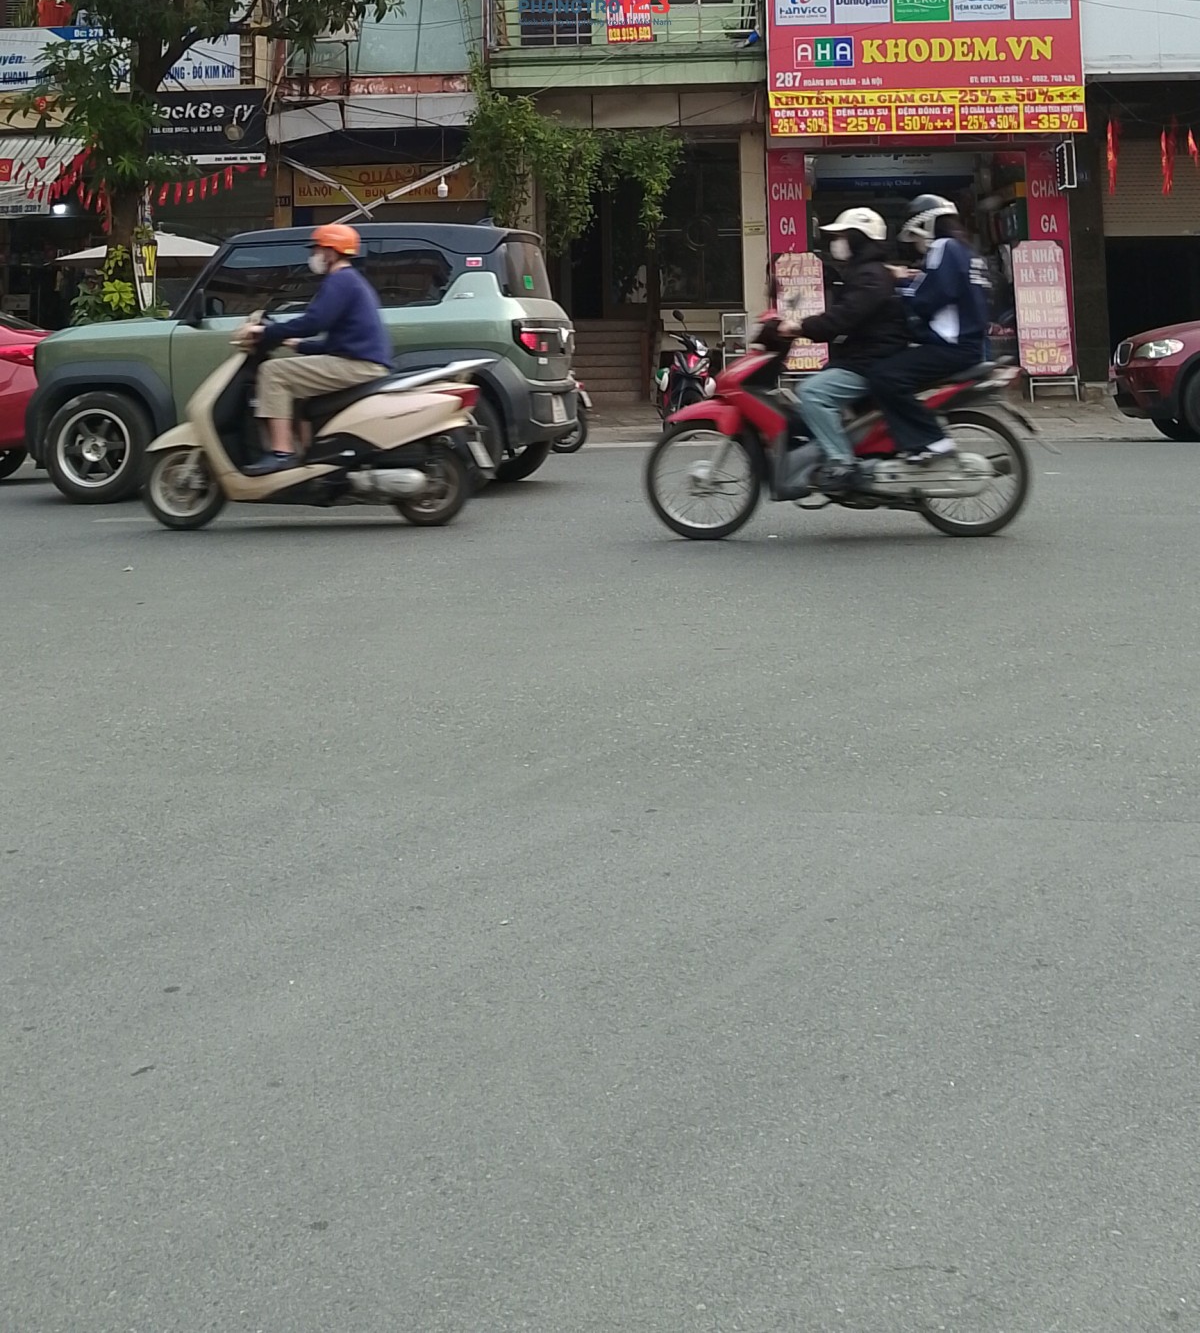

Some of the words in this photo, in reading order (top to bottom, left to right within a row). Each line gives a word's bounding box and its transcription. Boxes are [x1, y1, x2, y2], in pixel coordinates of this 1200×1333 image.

[797, 42, 851, 62] AHA
[861, 36, 1054, 64] KHODEM.VN
[204, 65, 220, 79] KIM
[776, 72, 802, 87] 287
[949, 89, 997, 103] -25%
[775, 108, 796, 118] ĐỆM
[811, 109, 825, 117] XO
[836, 107, 856, 116] ĐỆM
[857, 107, 875, 116] CAO
[876, 107, 888, 115] SU
[840, 117, 886, 132] -25%
[899, 115, 953, 132] -50%++
[1031, 113, 1079, 129] -35%
[771, 178, 802, 200] CHĂN
[780, 217, 797, 235] GA
[1041, 214, 1058, 233] GA
[1025, 348, 1067, 365] 50%
